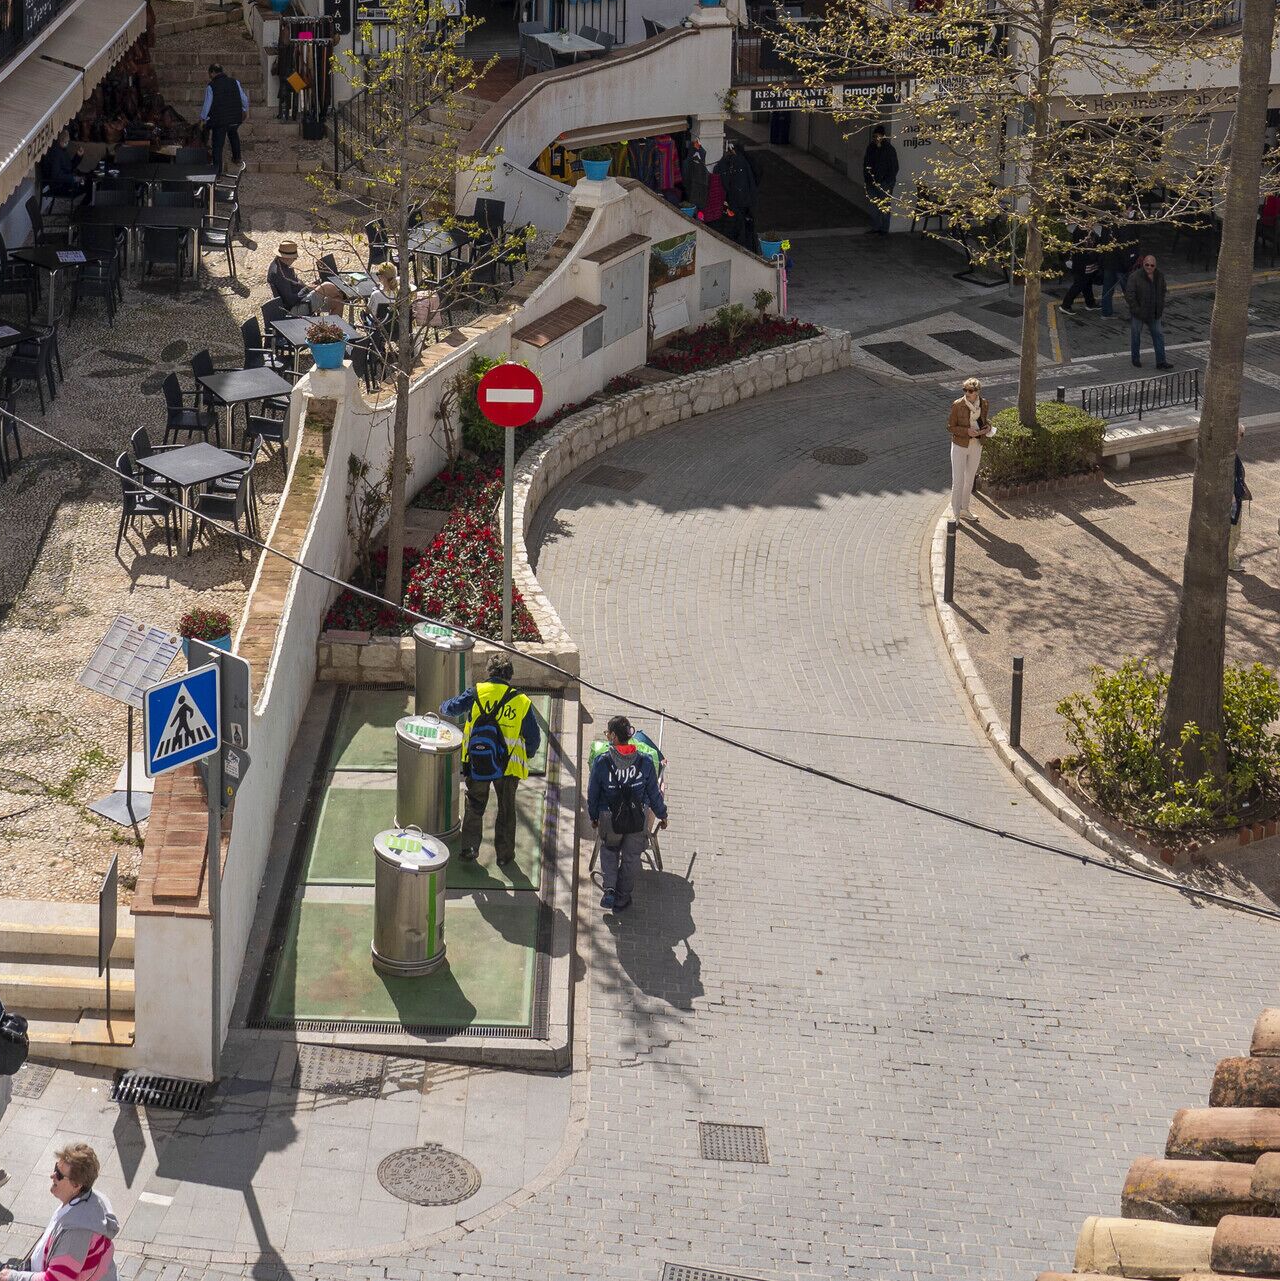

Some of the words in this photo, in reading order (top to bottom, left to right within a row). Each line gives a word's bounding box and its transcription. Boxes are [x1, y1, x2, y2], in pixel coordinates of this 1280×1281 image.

[760, 100, 774, 109] EL
[903, 137, 932, 151] mijas
[483, 700, 517, 721] Mjas
